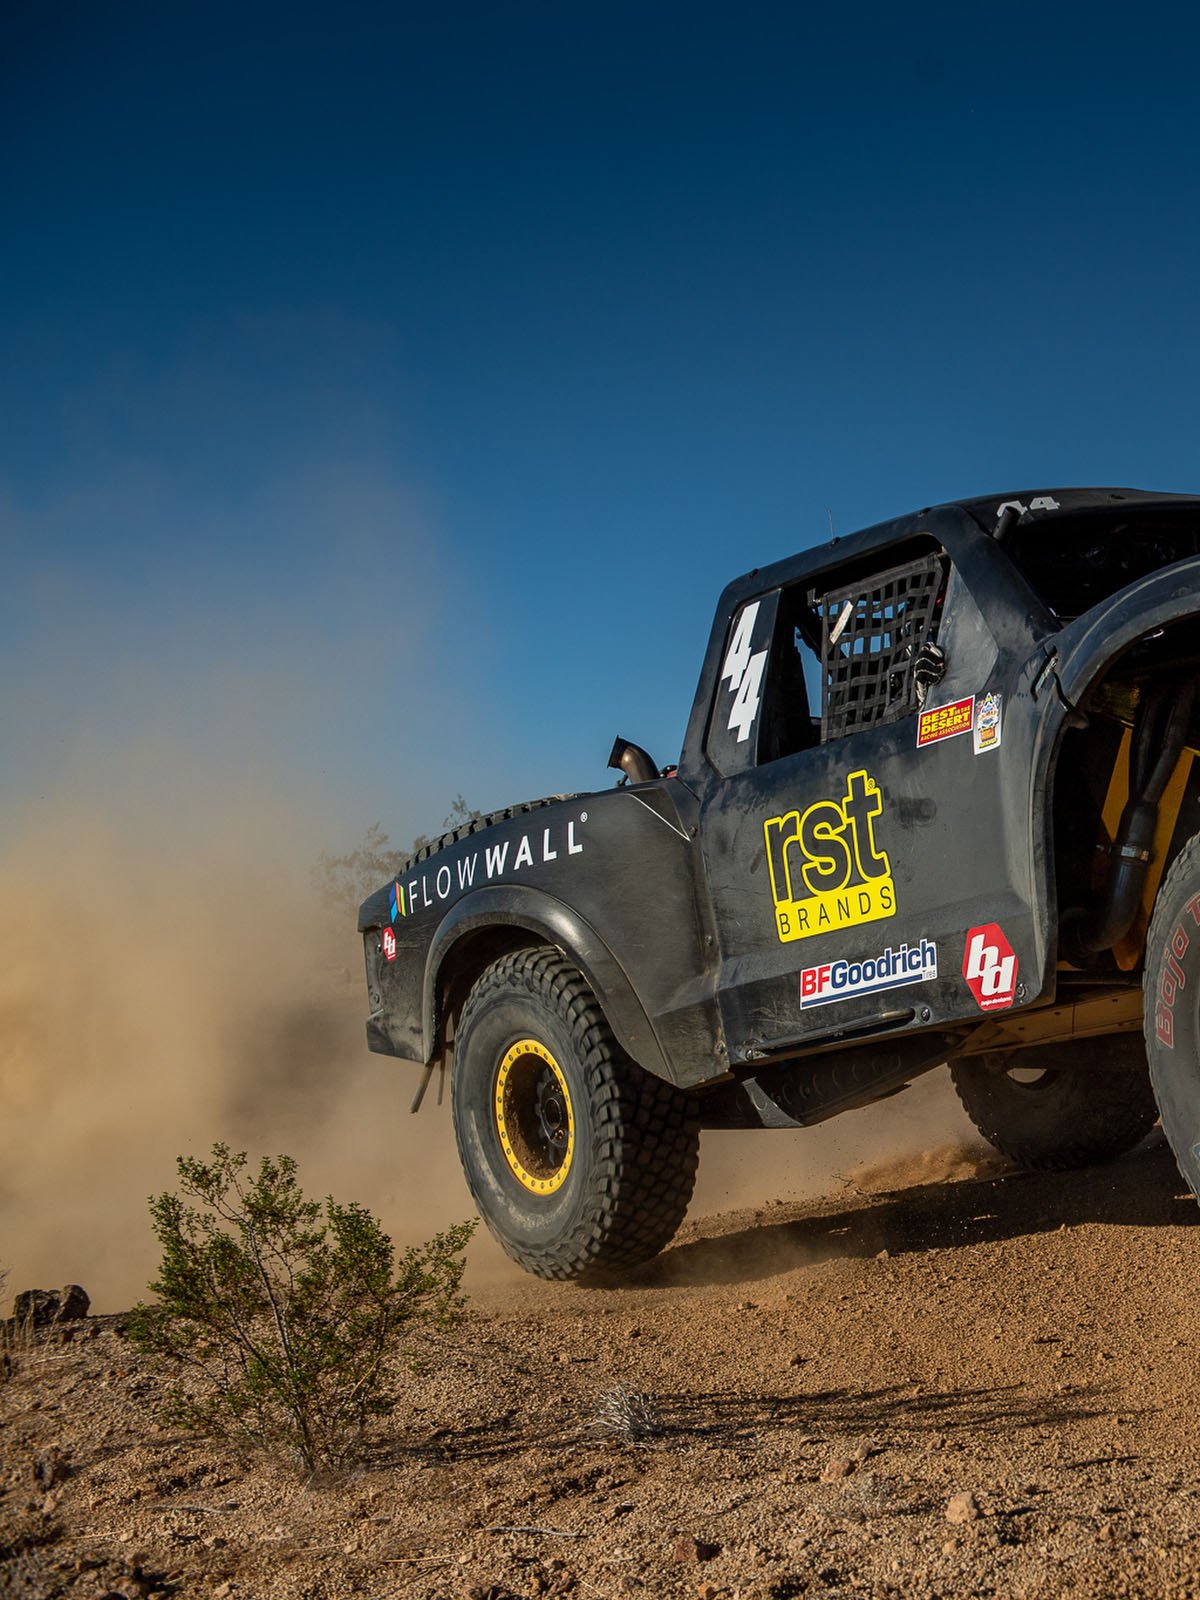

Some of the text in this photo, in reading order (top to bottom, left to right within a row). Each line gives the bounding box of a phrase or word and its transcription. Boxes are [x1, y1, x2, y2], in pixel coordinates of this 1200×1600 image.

[721, 601, 769, 743] 44
[921, 711, 970, 736] DESERT
[922, 706, 956, 726] BEST
[779, 886, 893, 936] BRANDS
[801, 940, 936, 998] BFGoodrich
[1155, 923, 1190, 1049] Baja
